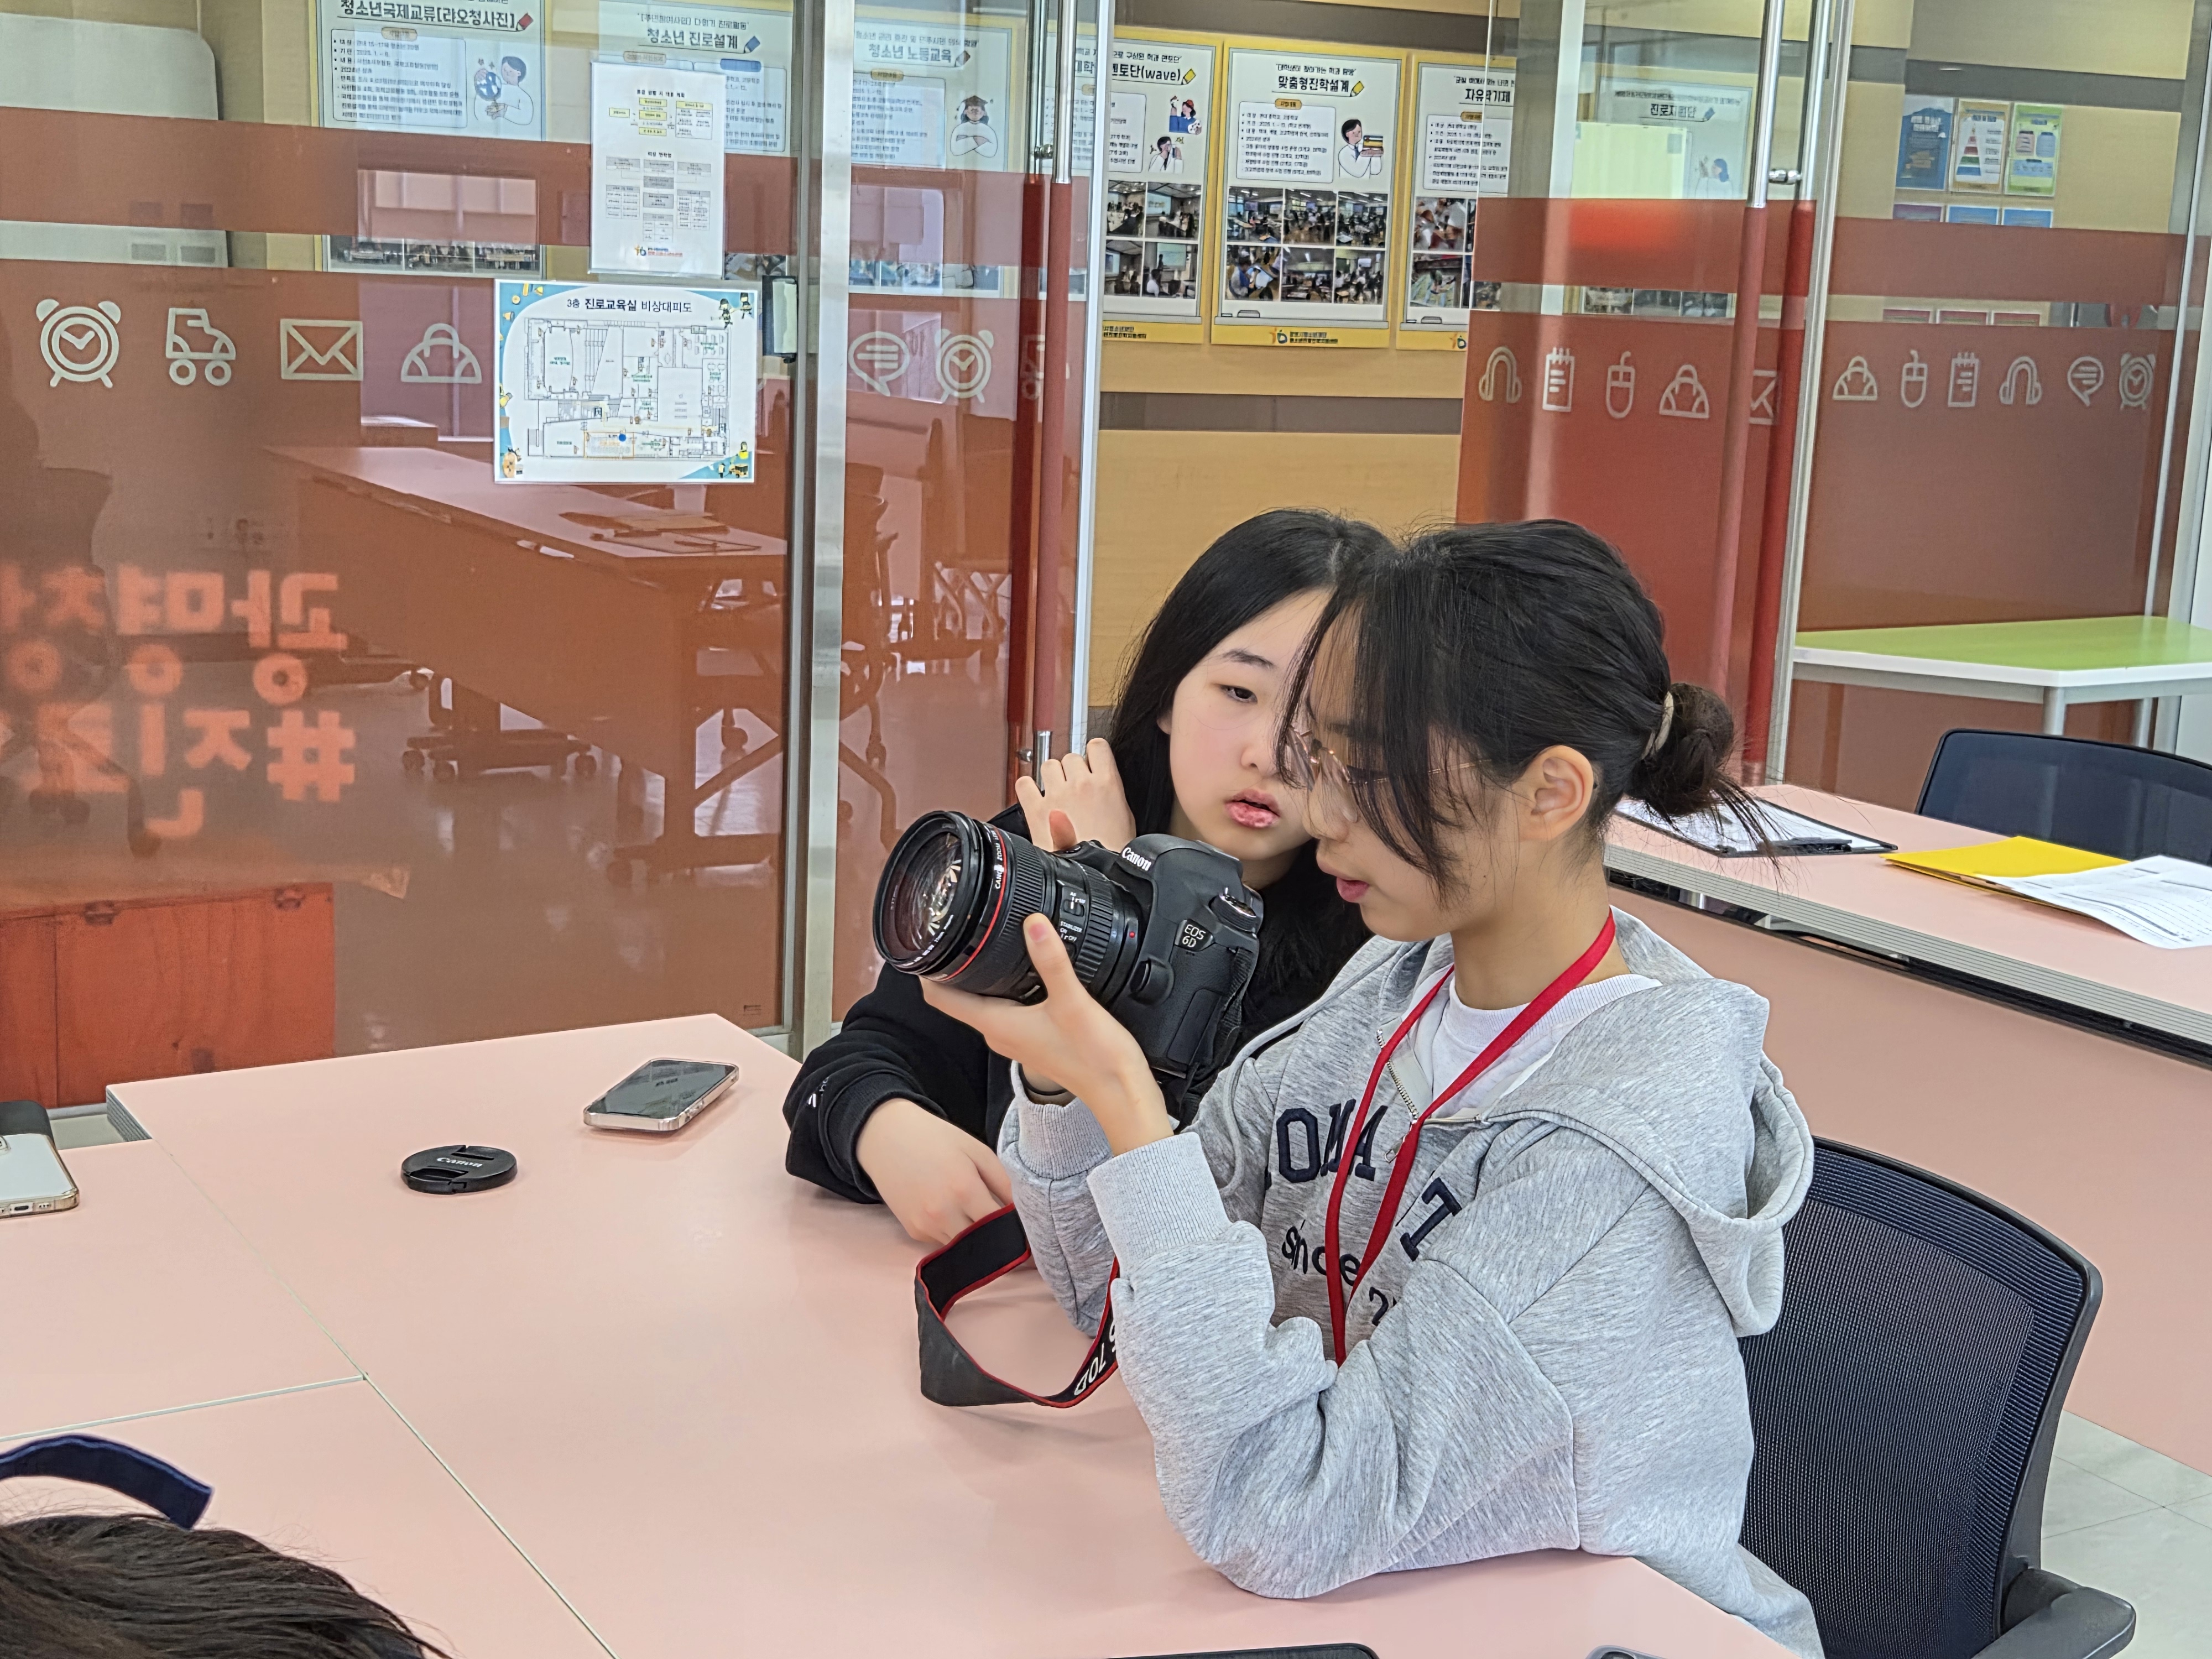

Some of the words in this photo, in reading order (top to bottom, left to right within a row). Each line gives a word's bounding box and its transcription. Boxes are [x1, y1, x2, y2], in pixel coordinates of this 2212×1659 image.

[647, 28, 685, 45] 청소년
[689, 31, 738, 49] 진로설계
[869, 44, 904, 59] 청소년
[907, 46, 952, 63] 노동교육
[1278, 75, 1349, 93] 맞춤형진학설계
[567, 298, 580, 309] 3층
[585, 298, 637, 311] 진로교육실
[641, 300, 692, 313] 비상대피도
[1122, 847, 1152, 871] Canon
[1184, 924, 1206, 940] EOS
[1182, 936, 1197, 948] 6D
[437, 1157, 483, 1167] Canon
